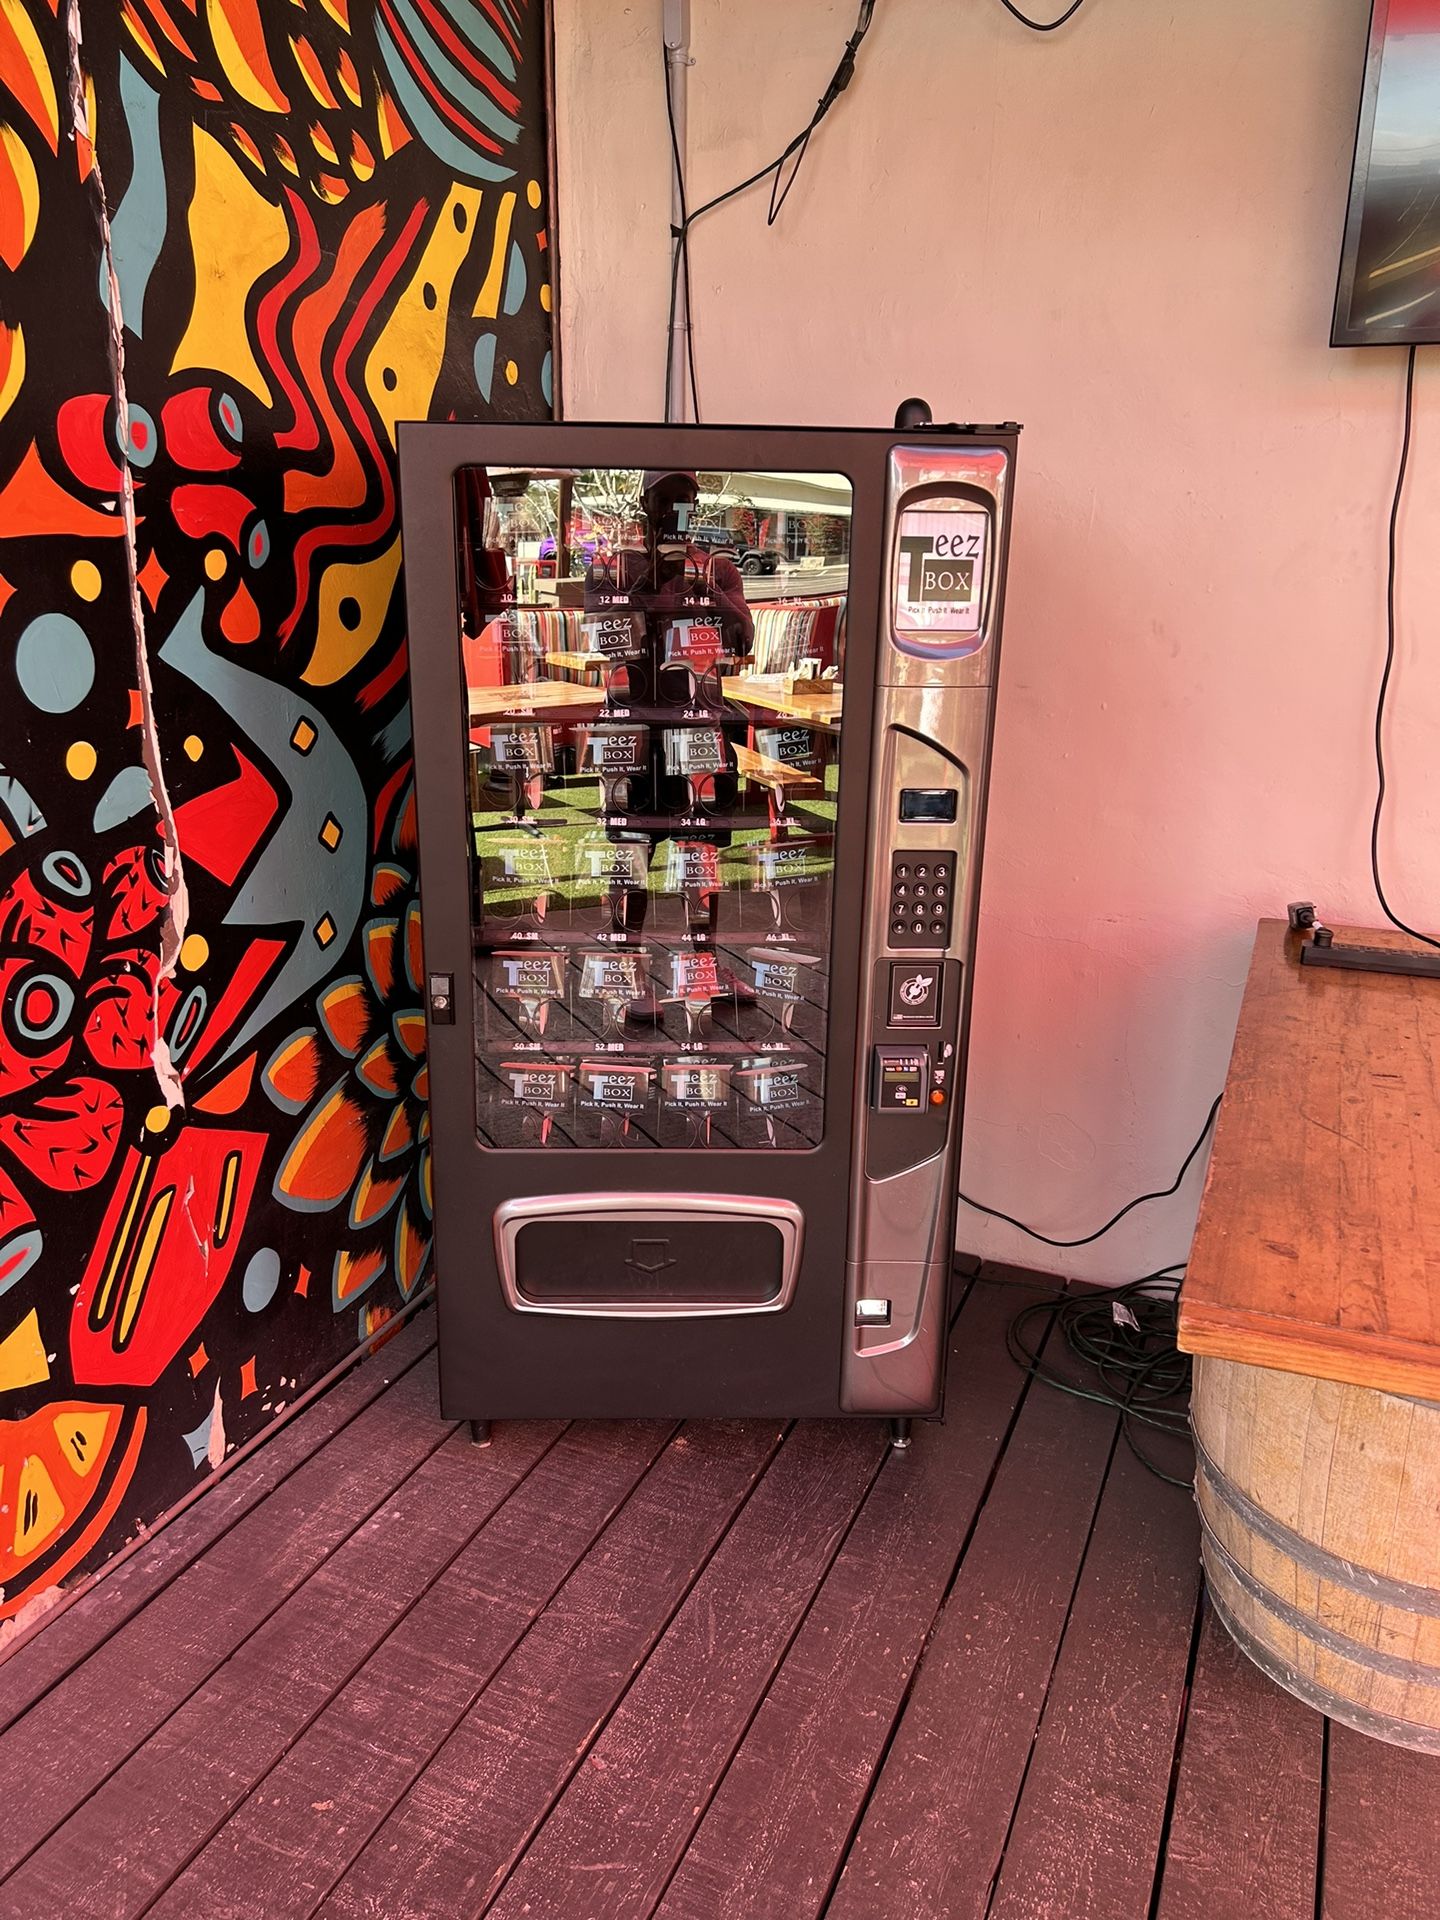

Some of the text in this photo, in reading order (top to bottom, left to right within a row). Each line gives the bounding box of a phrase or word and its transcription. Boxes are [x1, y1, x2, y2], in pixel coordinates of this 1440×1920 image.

[900, 534, 980, 603] Teez
[924, 571, 970, 591] BOX
[502, 593, 513, 601] 10
[599, 596, 629, 604] 12 MED
[684, 597, 695, 605] 14
[581, 617, 632, 652] Teez
[672, 615, 723, 647] Teez
[691, 631, 720, 641] BOX
[600, 633, 630, 645] BOX
[599, 709, 630, 717] 22 MED
[683, 710, 694, 718] 24
[490, 732, 538, 761] Teez
[671, 731, 722, 762] Teez
[761, 728, 809, 759] Teez
[506, 748, 535, 757] BOX
[587, 735, 637, 765] Teez
[604, 751, 633, 759] BOX
[690, 746, 719, 756] BOX
[779, 744, 807, 756] BOX
[610, 817, 627, 825] MED
[681, 818, 691, 826] 34
[500, 848, 549, 875] Teez
[585, 850, 634, 877] Teez
[671, 850, 720, 879] Teez
[758, 848, 806, 879] Teez
[516, 863, 545, 871] BOX
[601, 864, 630, 872] BOX
[687, 866, 714, 875] BOX
[776, 864, 803, 873] BOX
[900, 867, 946, 877] 1 2 3
[899, 886, 944, 895] 4 5 6
[898, 905, 942, 914] 7 8 9
[916, 923, 922, 933] 0
[511, 932, 522, 940] 40
[597, 933, 627, 941] 42 MED
[503, 960, 551, 986] Teez
[589, 960, 637, 986] Teez
[671, 956, 718, 985] Teez
[687, 970, 715, 980] BOX
[752, 961, 798, 987] Teez
[519, 974, 547, 982] BOX
[605, 974, 633, 983] BOX
[764, 976, 791, 988] BOX
[761, 989, 777, 997] Push
[514, 1042, 524, 1050] 50
[608, 1043, 624, 1051] MED
[680, 1042, 690, 1050] 54
[509, 1072, 556, 1098] Teez
[588, 1074, 636, 1100] Teez
[671, 1072, 718, 1099] Teez
[754, 1073, 799, 1104] Teez
[524, 1086, 551, 1095] BOX
[603, 1088, 631, 1097] BOX
[687, 1087, 713, 1095] BOX
[770, 1088, 796, 1098] BOX
[601, 1101, 617, 1109] Push
